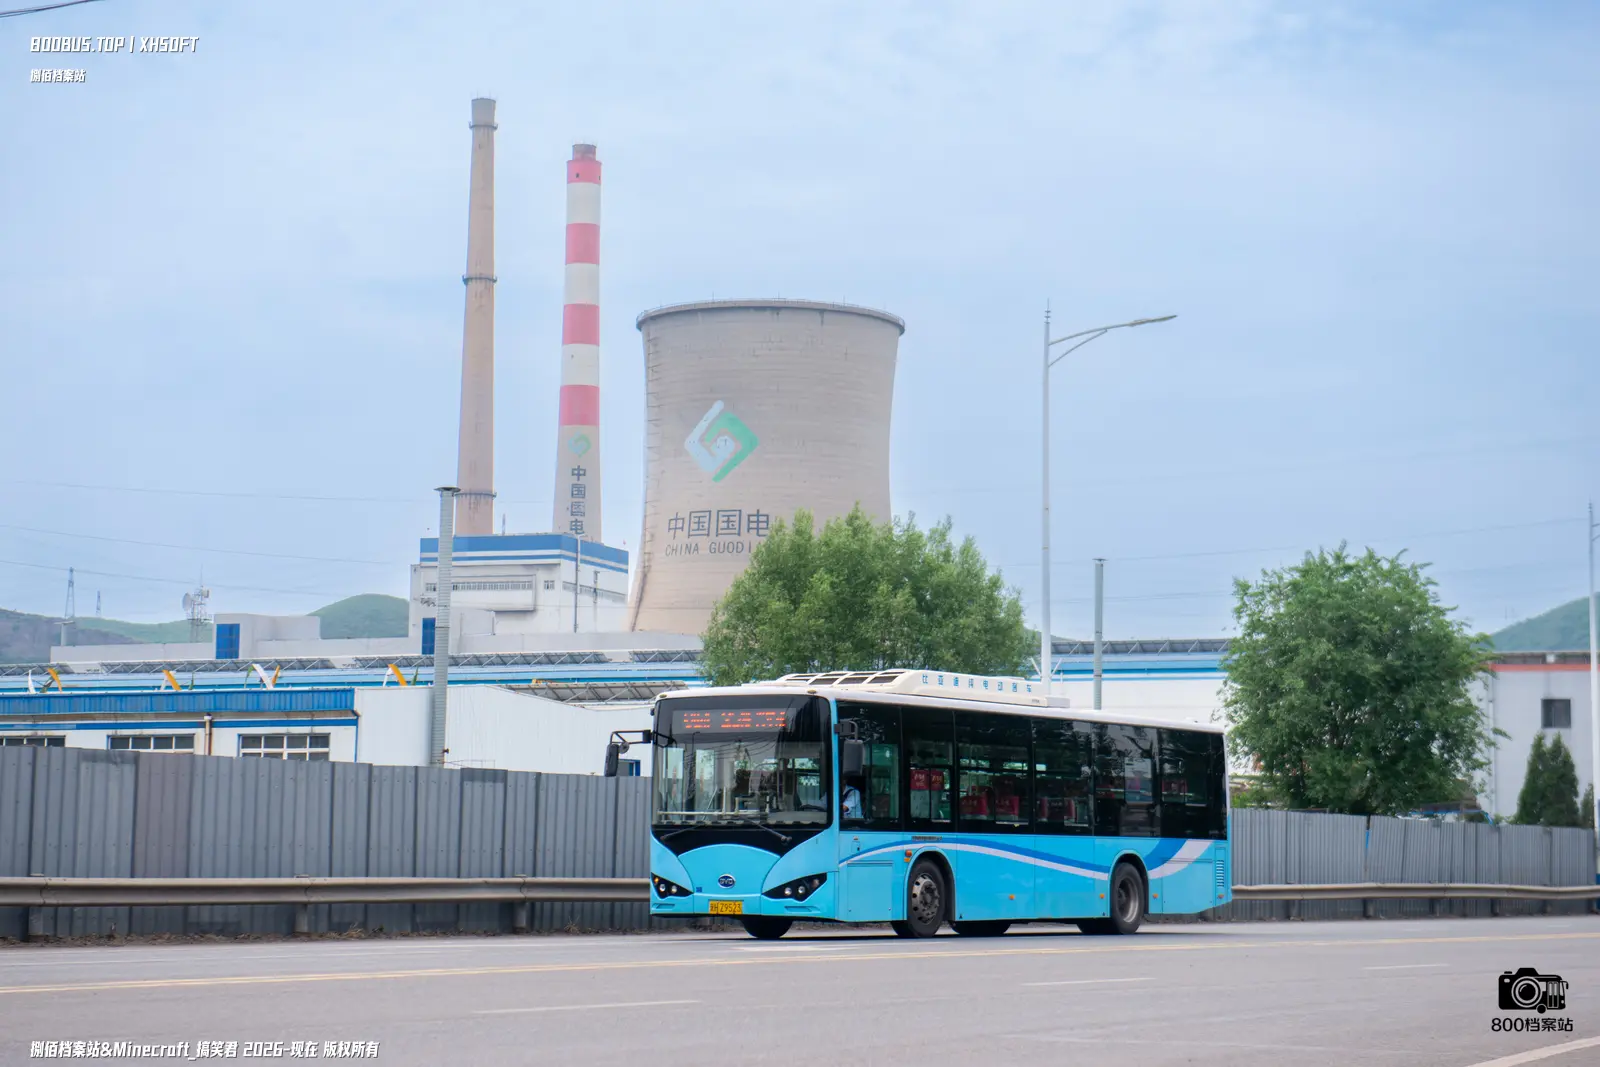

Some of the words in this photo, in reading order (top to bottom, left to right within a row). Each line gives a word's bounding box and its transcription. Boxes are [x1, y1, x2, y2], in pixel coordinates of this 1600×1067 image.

[570, 465, 586, 535] 中国国电
[667, 509, 769, 540] 中国国电
[665, 543, 699, 556] CHINA
[709, 541, 761, 554] GUODI
